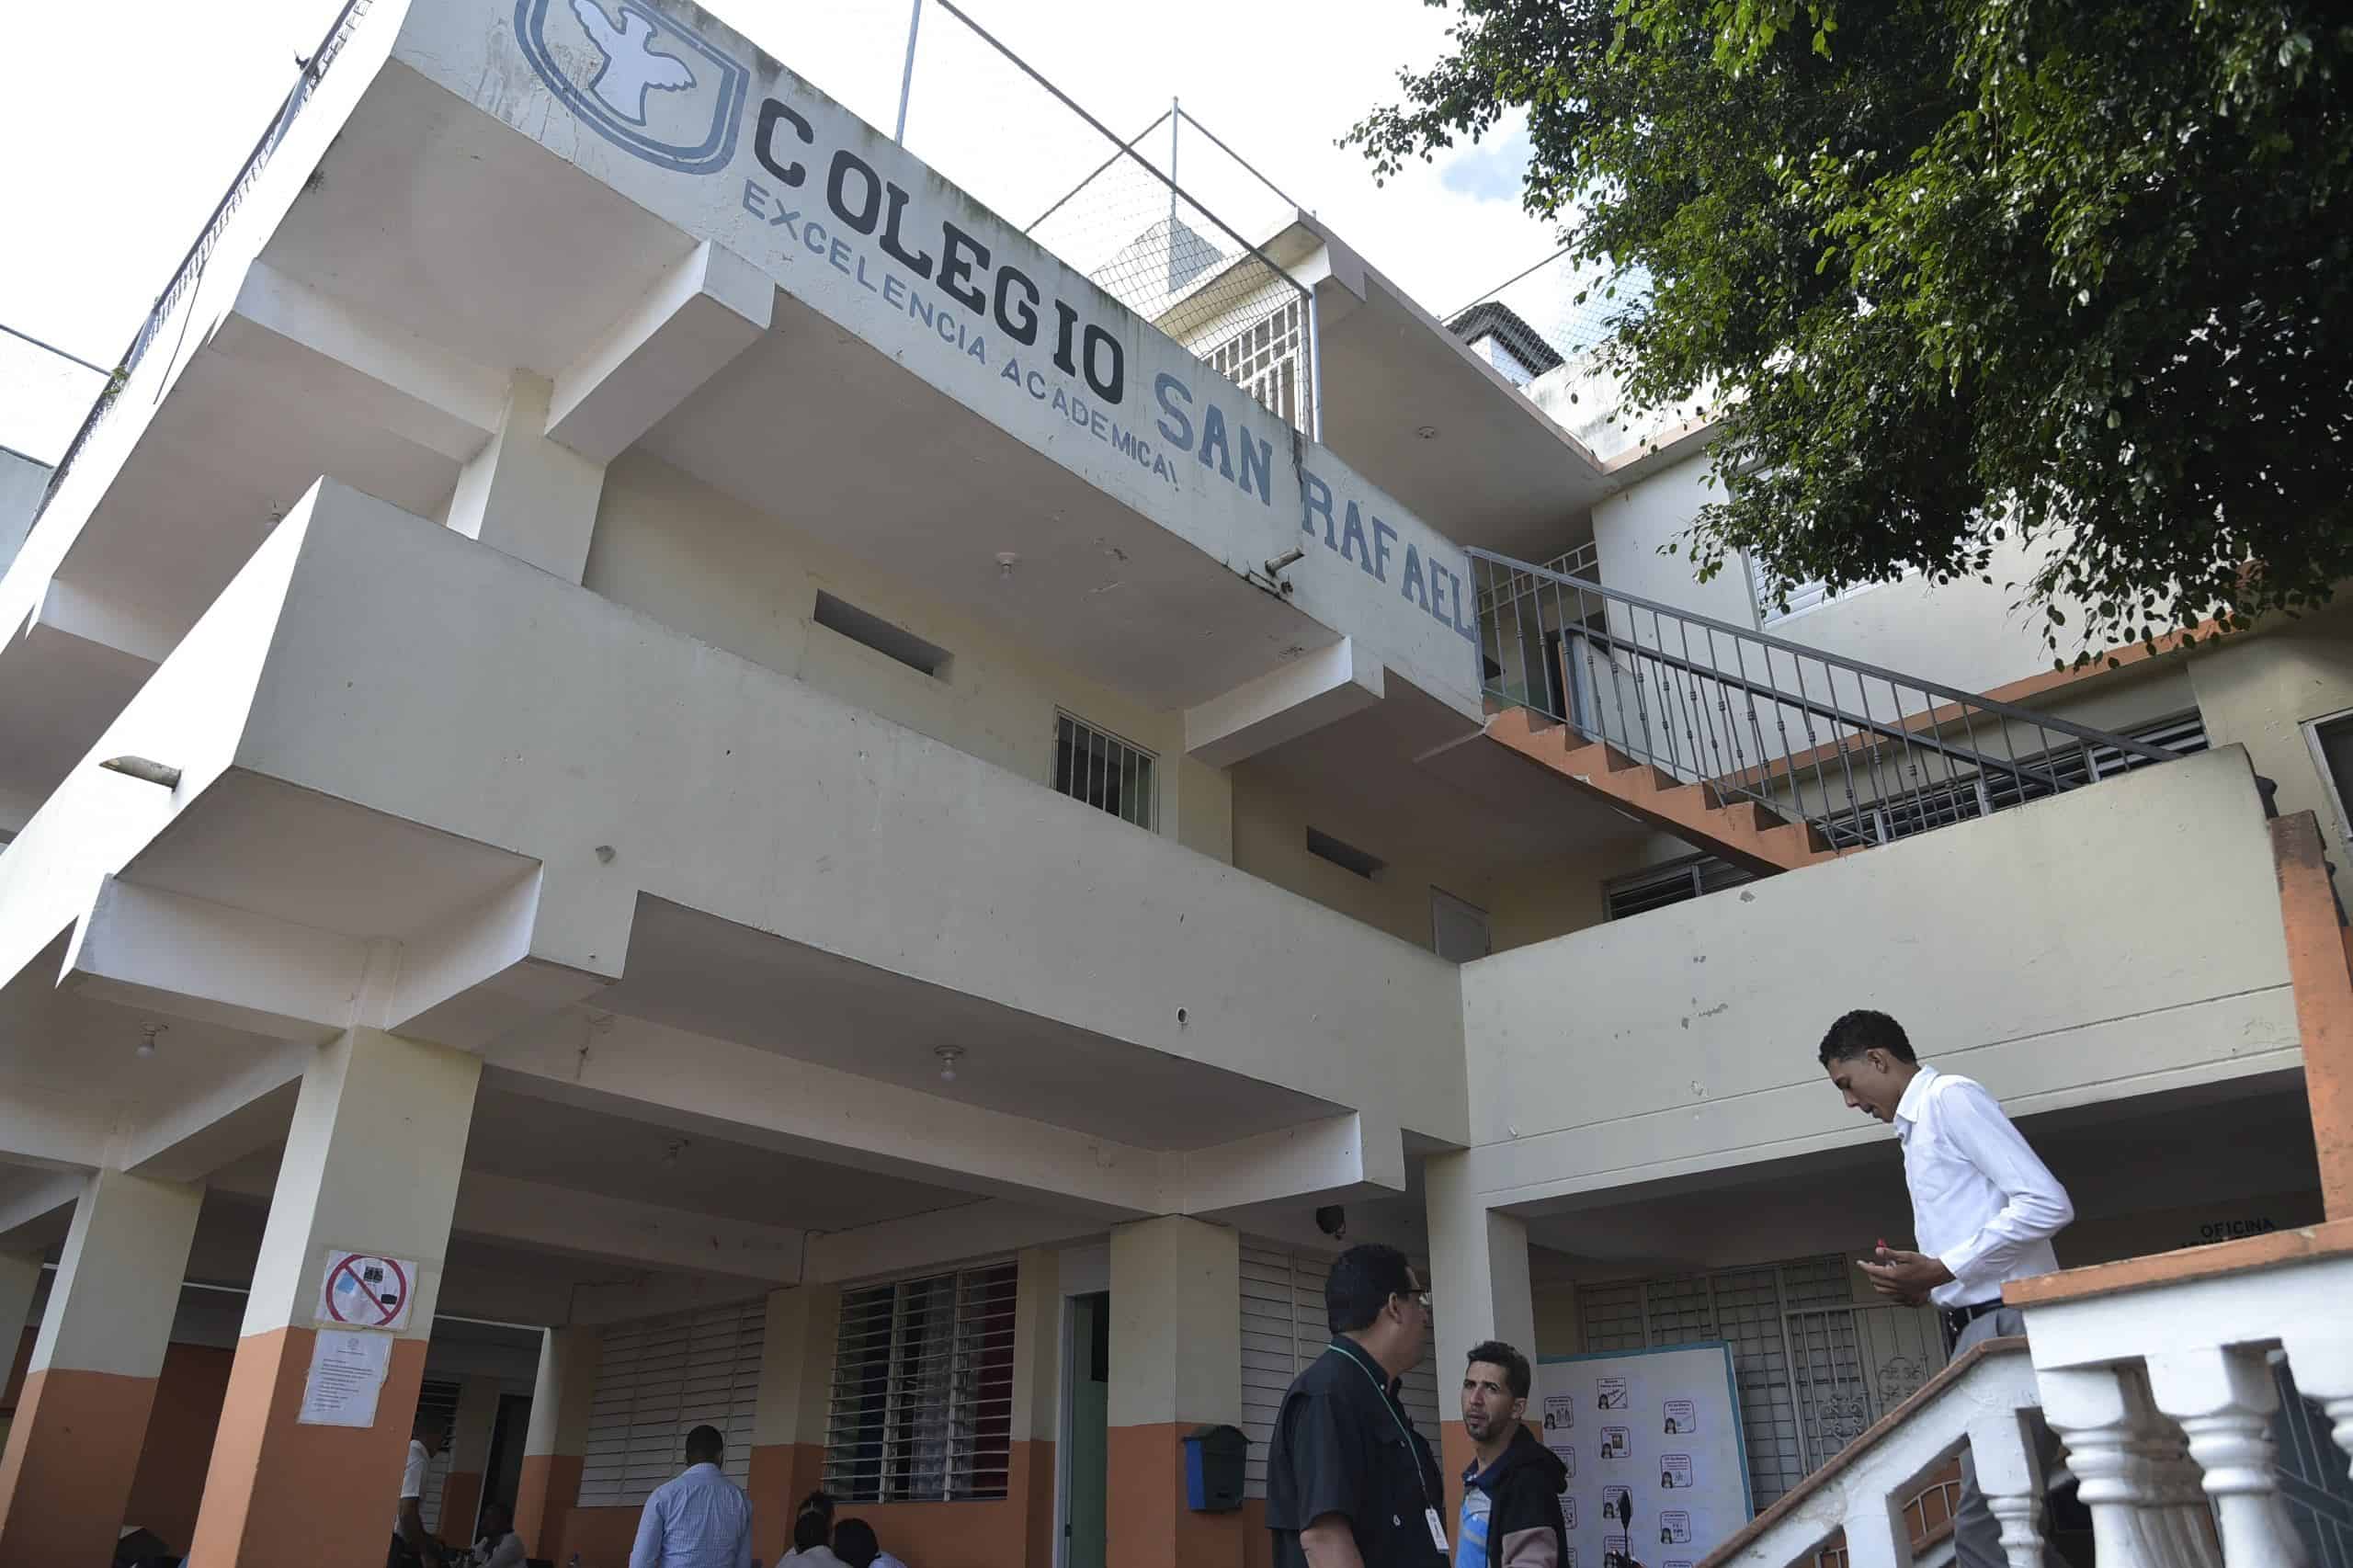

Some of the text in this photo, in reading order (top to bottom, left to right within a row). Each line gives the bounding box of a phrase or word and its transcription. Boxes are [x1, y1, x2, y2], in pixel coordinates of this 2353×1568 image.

[742, 178, 986, 365] EXCELENCIA
[754, 97, 1475, 642] COLEGIO SAN RAFAEL
[2200, 1218, 2274, 1238] OFICINA
